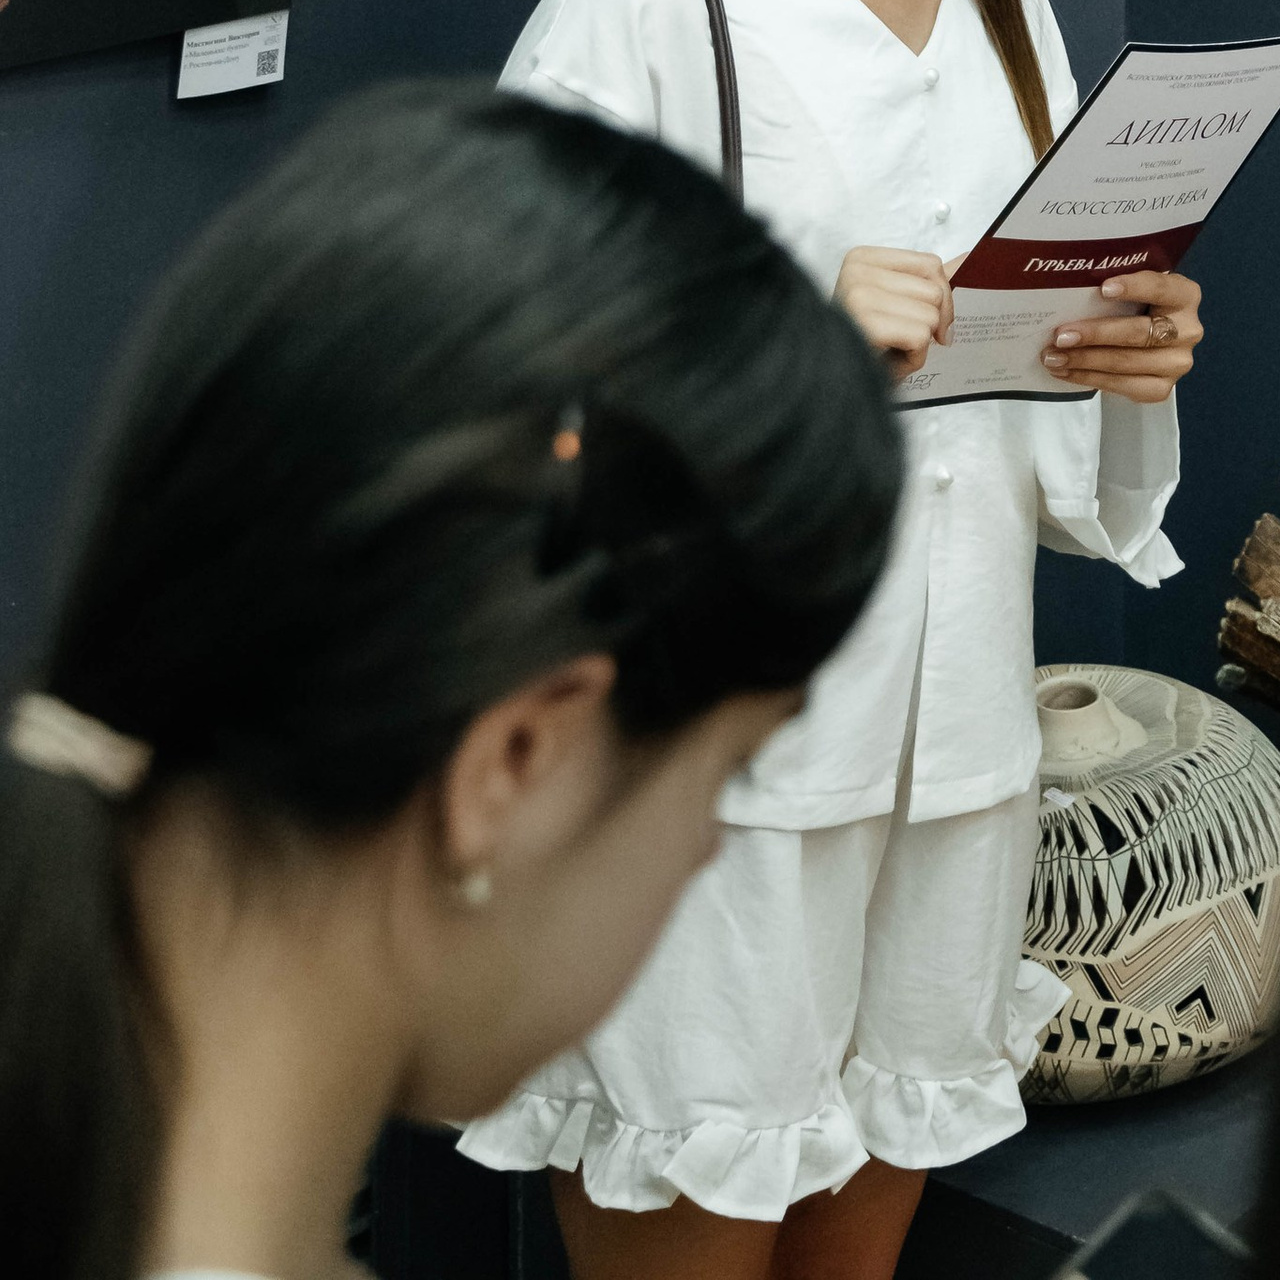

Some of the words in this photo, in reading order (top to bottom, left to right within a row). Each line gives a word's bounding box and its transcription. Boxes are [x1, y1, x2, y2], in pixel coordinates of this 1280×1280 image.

[1105, 108, 1252, 147] ДИПЛОМ
[1039, 198, 1147, 215] ИСКУССТВО
[1146, 195, 1175, 211] XXI
[1174, 187, 1209, 207] ВЕКА
[1022, 257, 1095, 272] ГУРЬЕВА
[1094, 250, 1149, 270] ДИАНА
